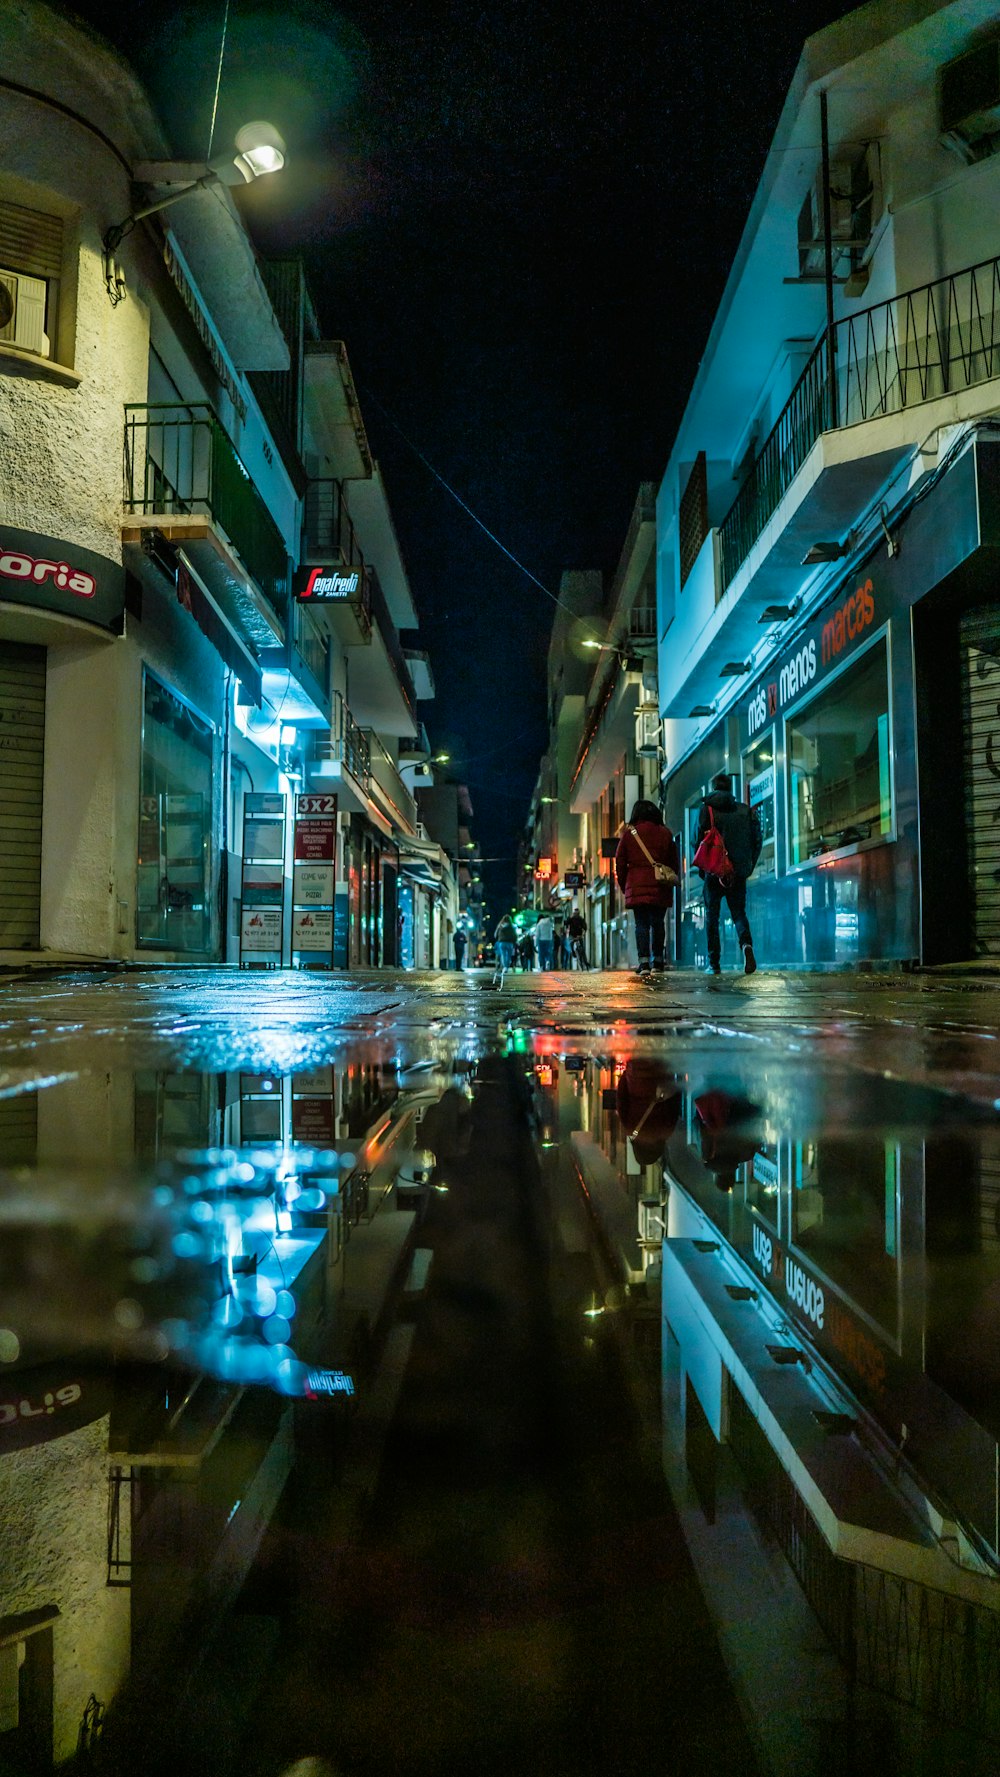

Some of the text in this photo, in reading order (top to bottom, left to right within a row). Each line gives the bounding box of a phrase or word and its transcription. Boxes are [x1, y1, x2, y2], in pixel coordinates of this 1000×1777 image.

[299, 567, 359, 598] Segafredo
[748, 684, 767, 737] más
[779, 638, 817, 707] menos
[821, 578, 875, 667] marcas
[299, 795, 335, 813] 3x2
